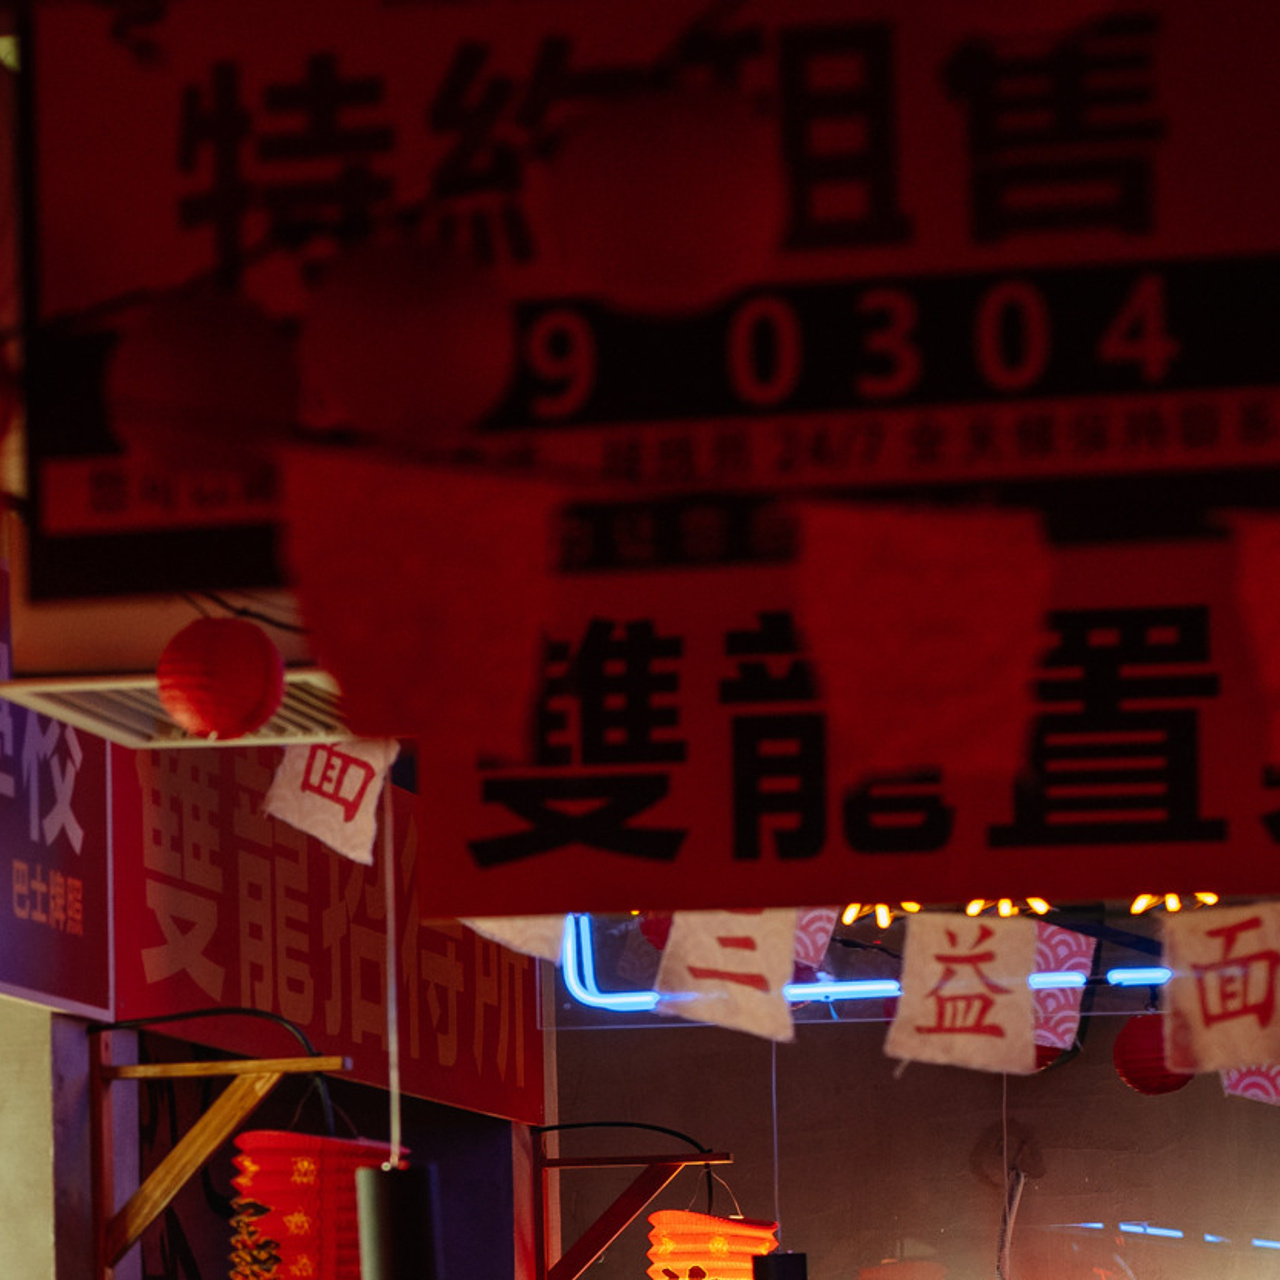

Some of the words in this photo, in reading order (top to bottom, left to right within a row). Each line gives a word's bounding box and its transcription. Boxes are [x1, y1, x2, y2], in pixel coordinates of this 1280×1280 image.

[727, 272, 1182, 408] 0304
[468, 605, 1280, 868] 雙龍置
[914, 924, 1010, 1038] 益
[1191, 917, 1278, 1028] 面
